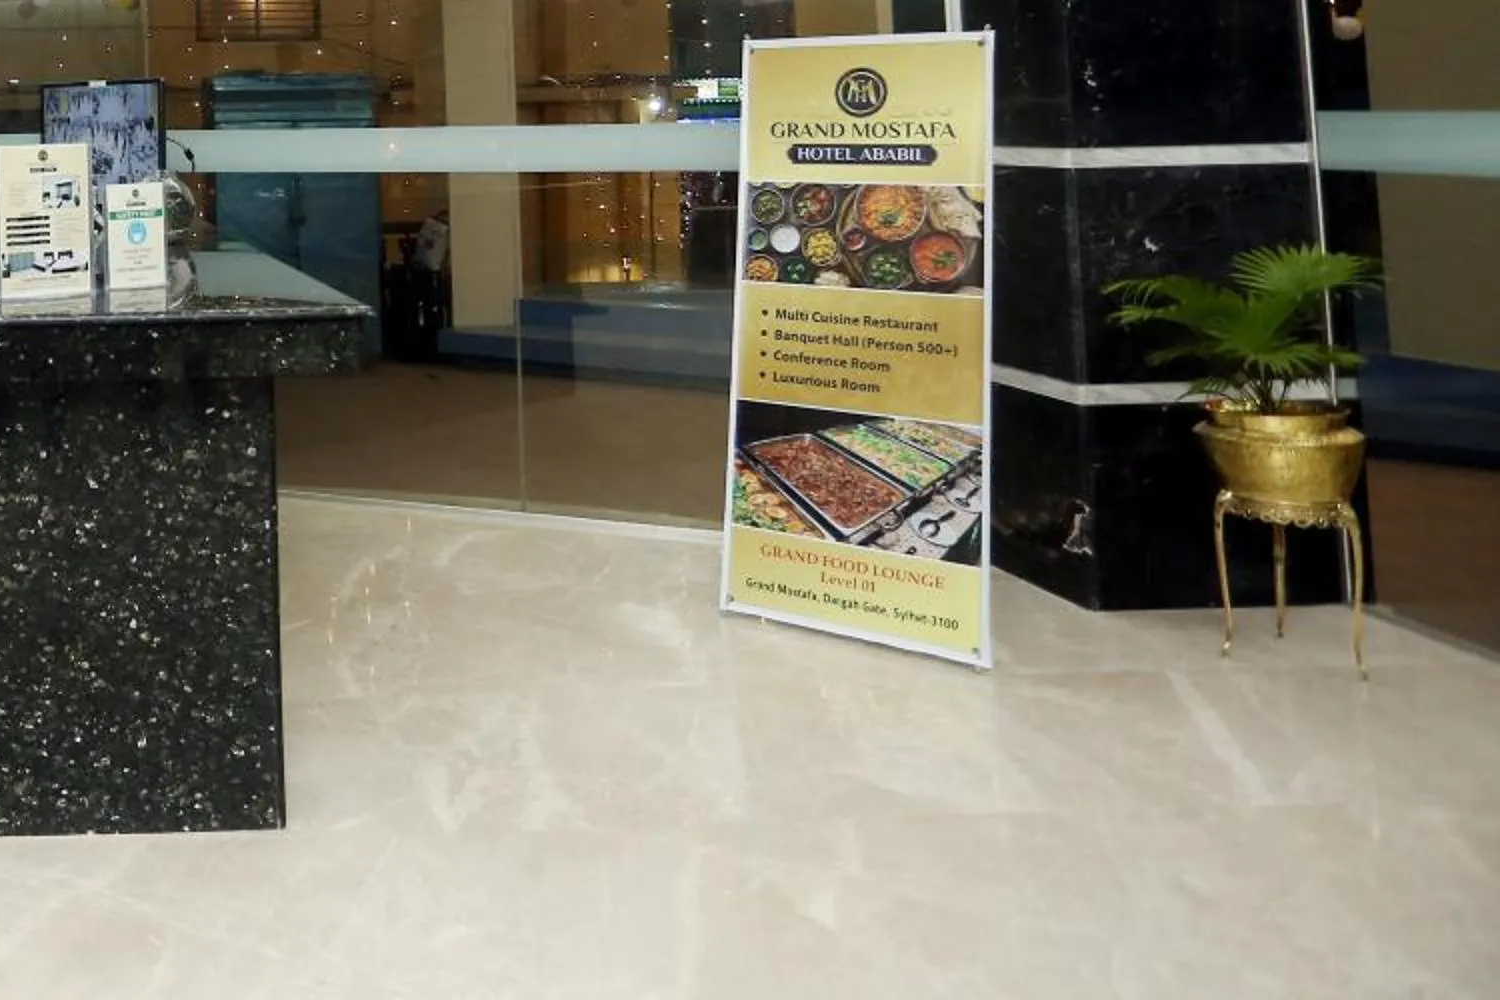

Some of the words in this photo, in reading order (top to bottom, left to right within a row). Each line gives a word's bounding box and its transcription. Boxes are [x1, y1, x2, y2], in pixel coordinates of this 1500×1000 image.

[770, 121, 846, 139] GRAND
[851, 121, 957, 139] MOSTAFA
[797, 147, 856, 161] HOTEL
[860, 147, 926, 161] ABABIL
[775, 308, 810, 322] Multi
[811, 311, 860, 326] Cuisine
[863, 315, 939, 333] Restaurant
[774, 329, 830, 345] Banquet
[832, 333, 860, 348] Hall
[861, 336, 913, 353] (Person
[773, 349, 848, 369] Conference
[850, 357, 891, 373] Room
[772, 371, 838, 389] Luxurious
[840, 378, 881, 393] Room
[760, 544, 820, 565] GRAND
[822, 555, 869, 574] FOOD
[873, 563, 945, 590] LOUNGE
[745, 577, 776, 593] Grand
[820, 571, 858, 590] Level
